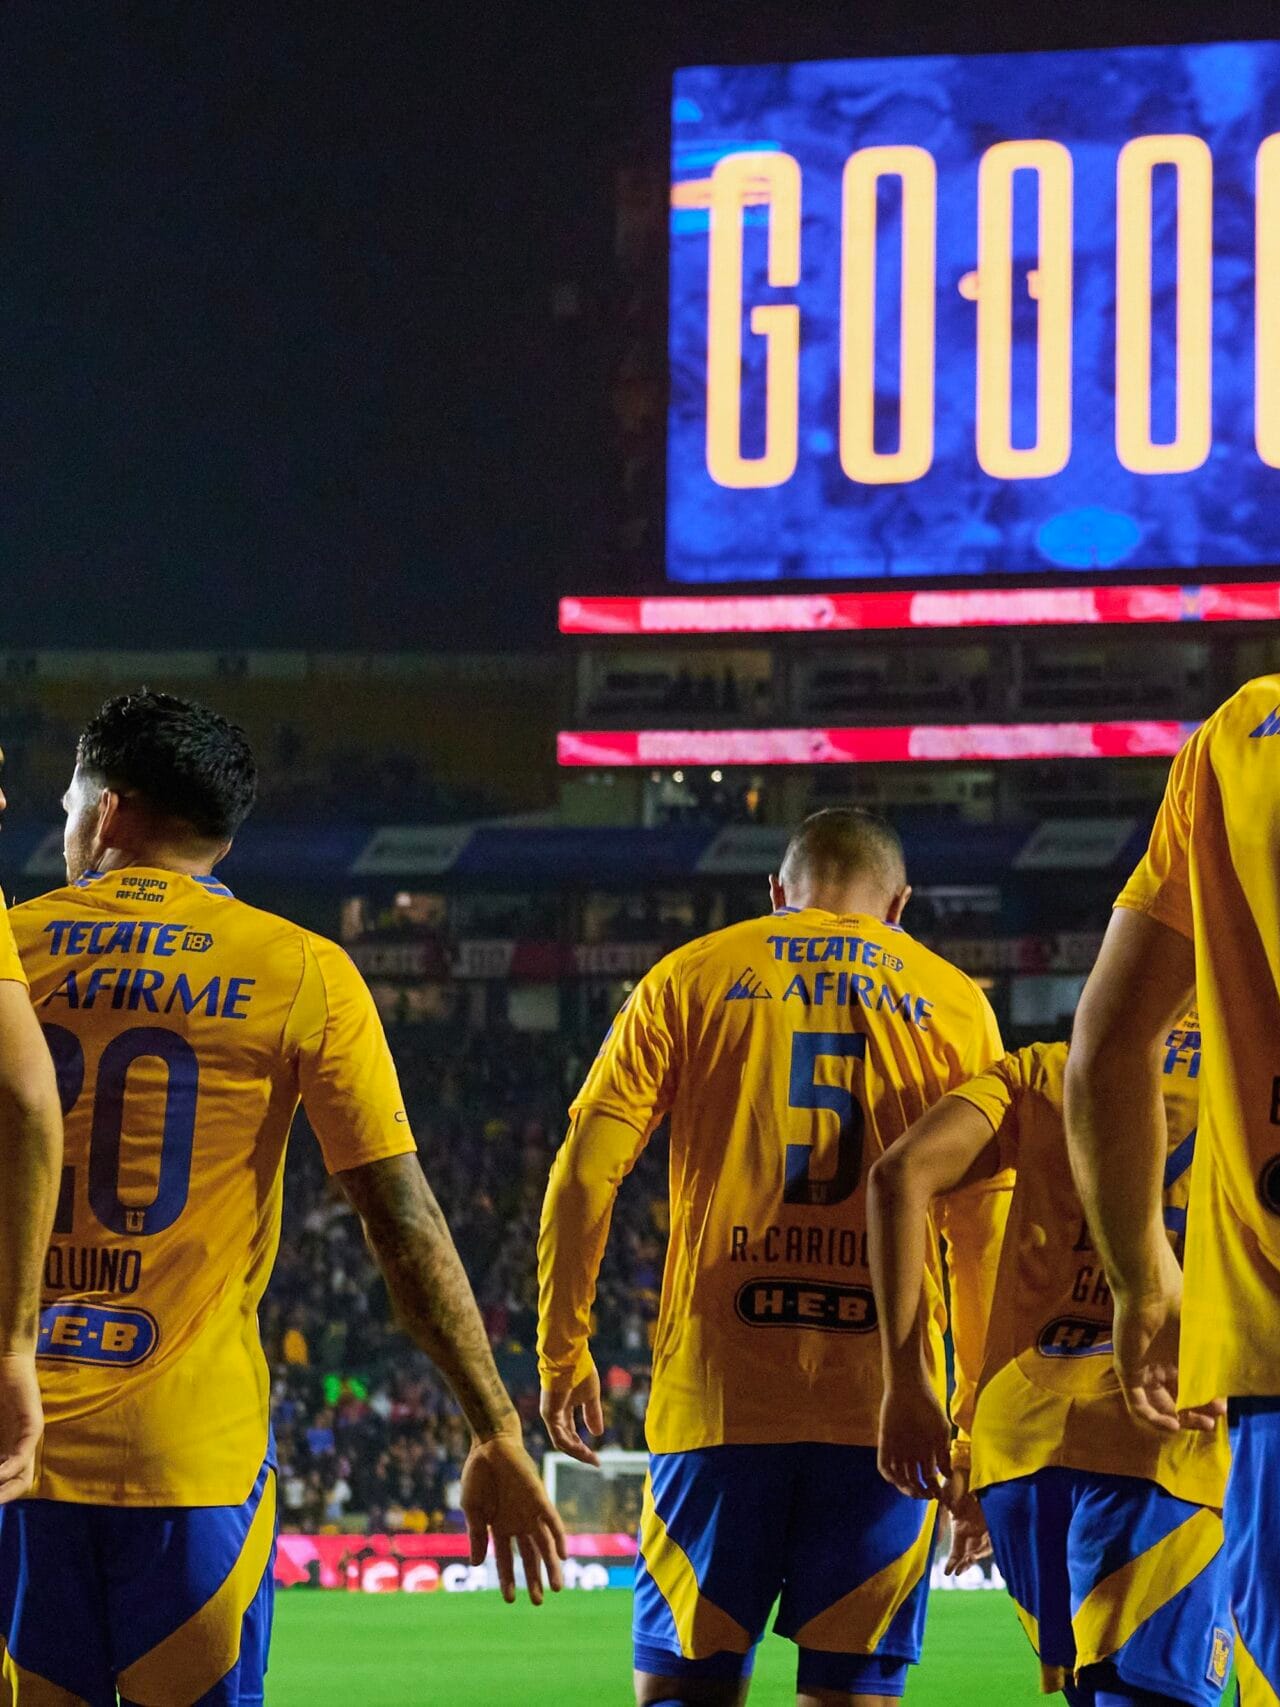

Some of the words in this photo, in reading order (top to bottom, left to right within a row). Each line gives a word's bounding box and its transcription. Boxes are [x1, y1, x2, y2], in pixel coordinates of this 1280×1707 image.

[115, 890, 164, 902] AFICION
[120, 877, 168, 890] EQUIPO
[44, 920, 188, 956] TECATE
[766, 936, 882, 968] TECATE
[41, 968, 256, 1019] AFIRME
[782, 972, 934, 1032] AFIRME
[783, 1032, 867, 1205] 5
[46, 1245, 142, 1293] QUINO
